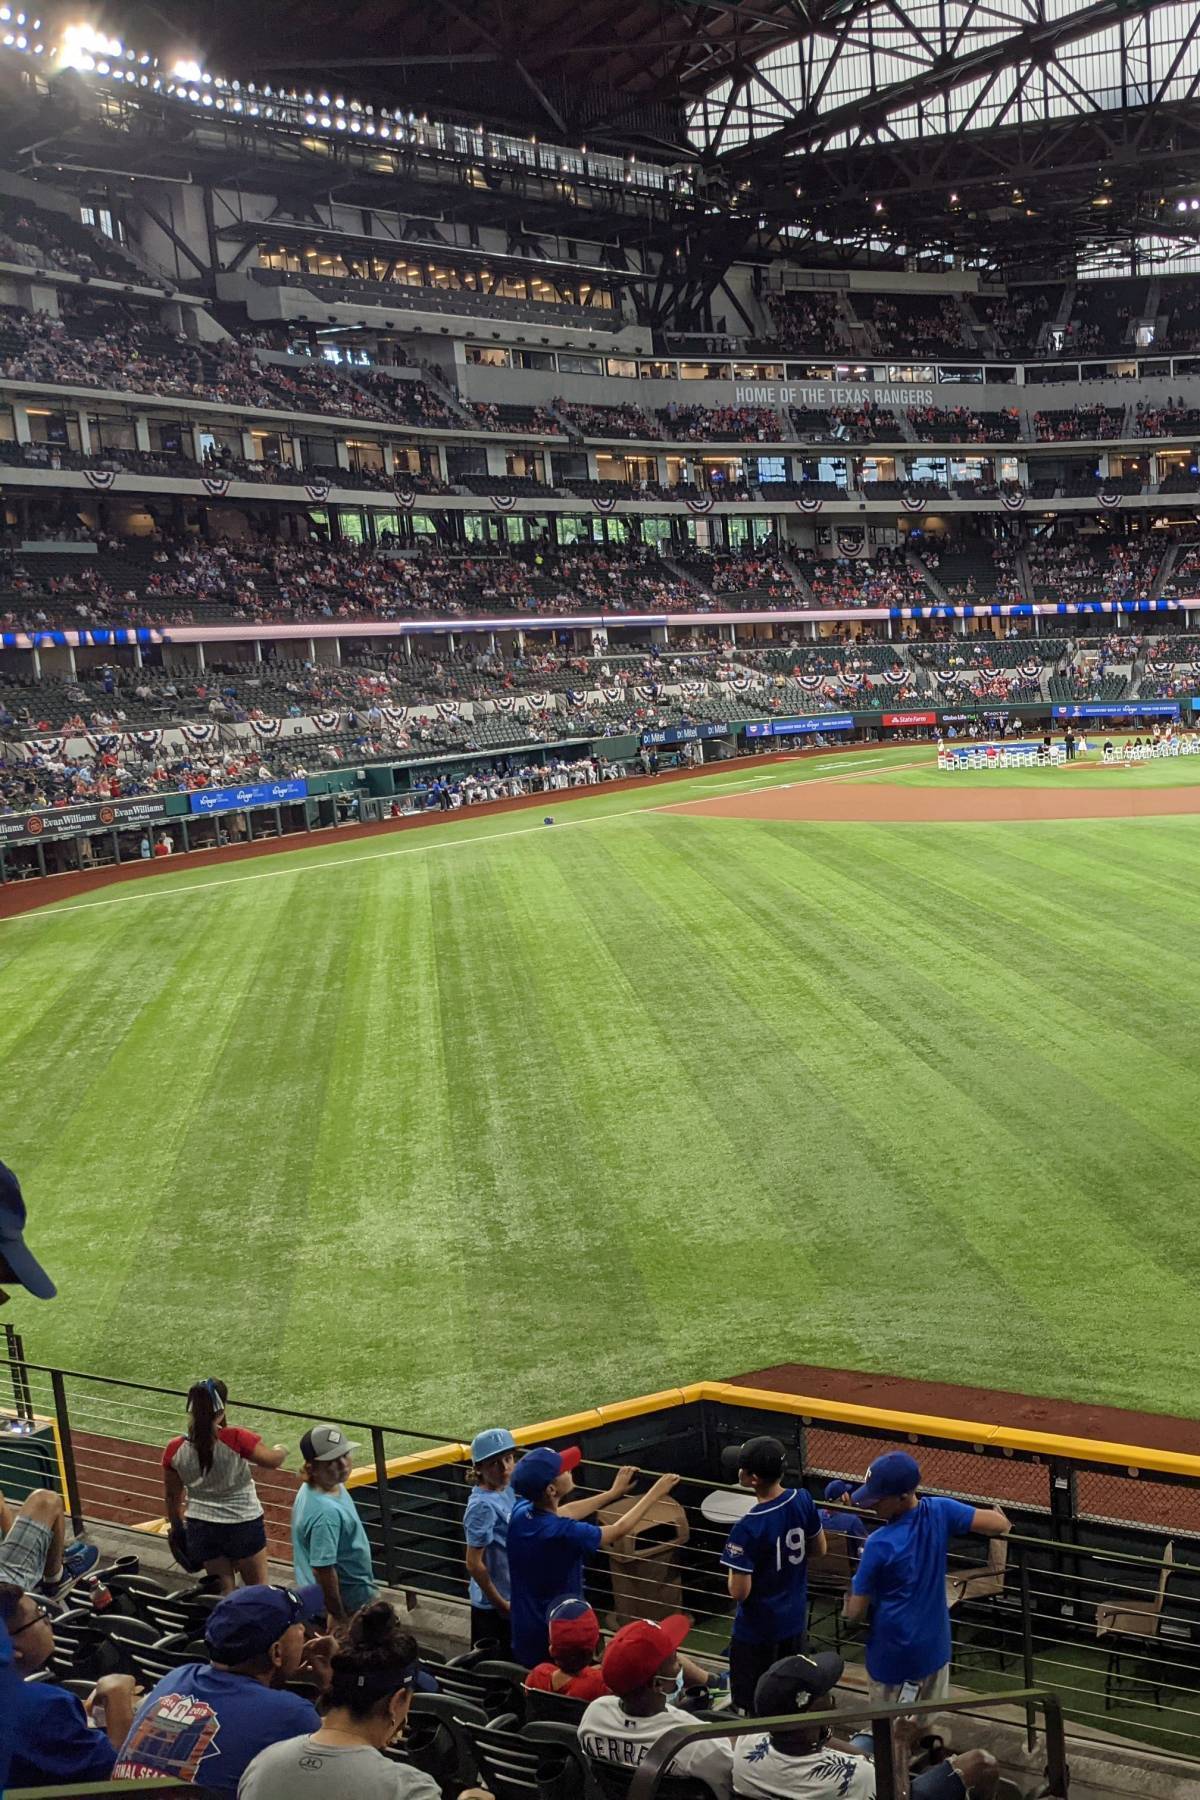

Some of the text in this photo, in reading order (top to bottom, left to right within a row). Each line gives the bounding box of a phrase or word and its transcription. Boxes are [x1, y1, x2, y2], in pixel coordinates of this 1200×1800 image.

[735, 387, 933, 404] HOME OF THE TEXAS RANGERS
[650, 731, 666, 742] Mitel
[682, 728, 698, 738] Mitel
[113, 804, 164, 818] Evan Williams
[43, 813, 97, 828] Evan Williams
[776, 1527, 806, 1572] 19
[114, 1763, 136, 1780] FINAL
